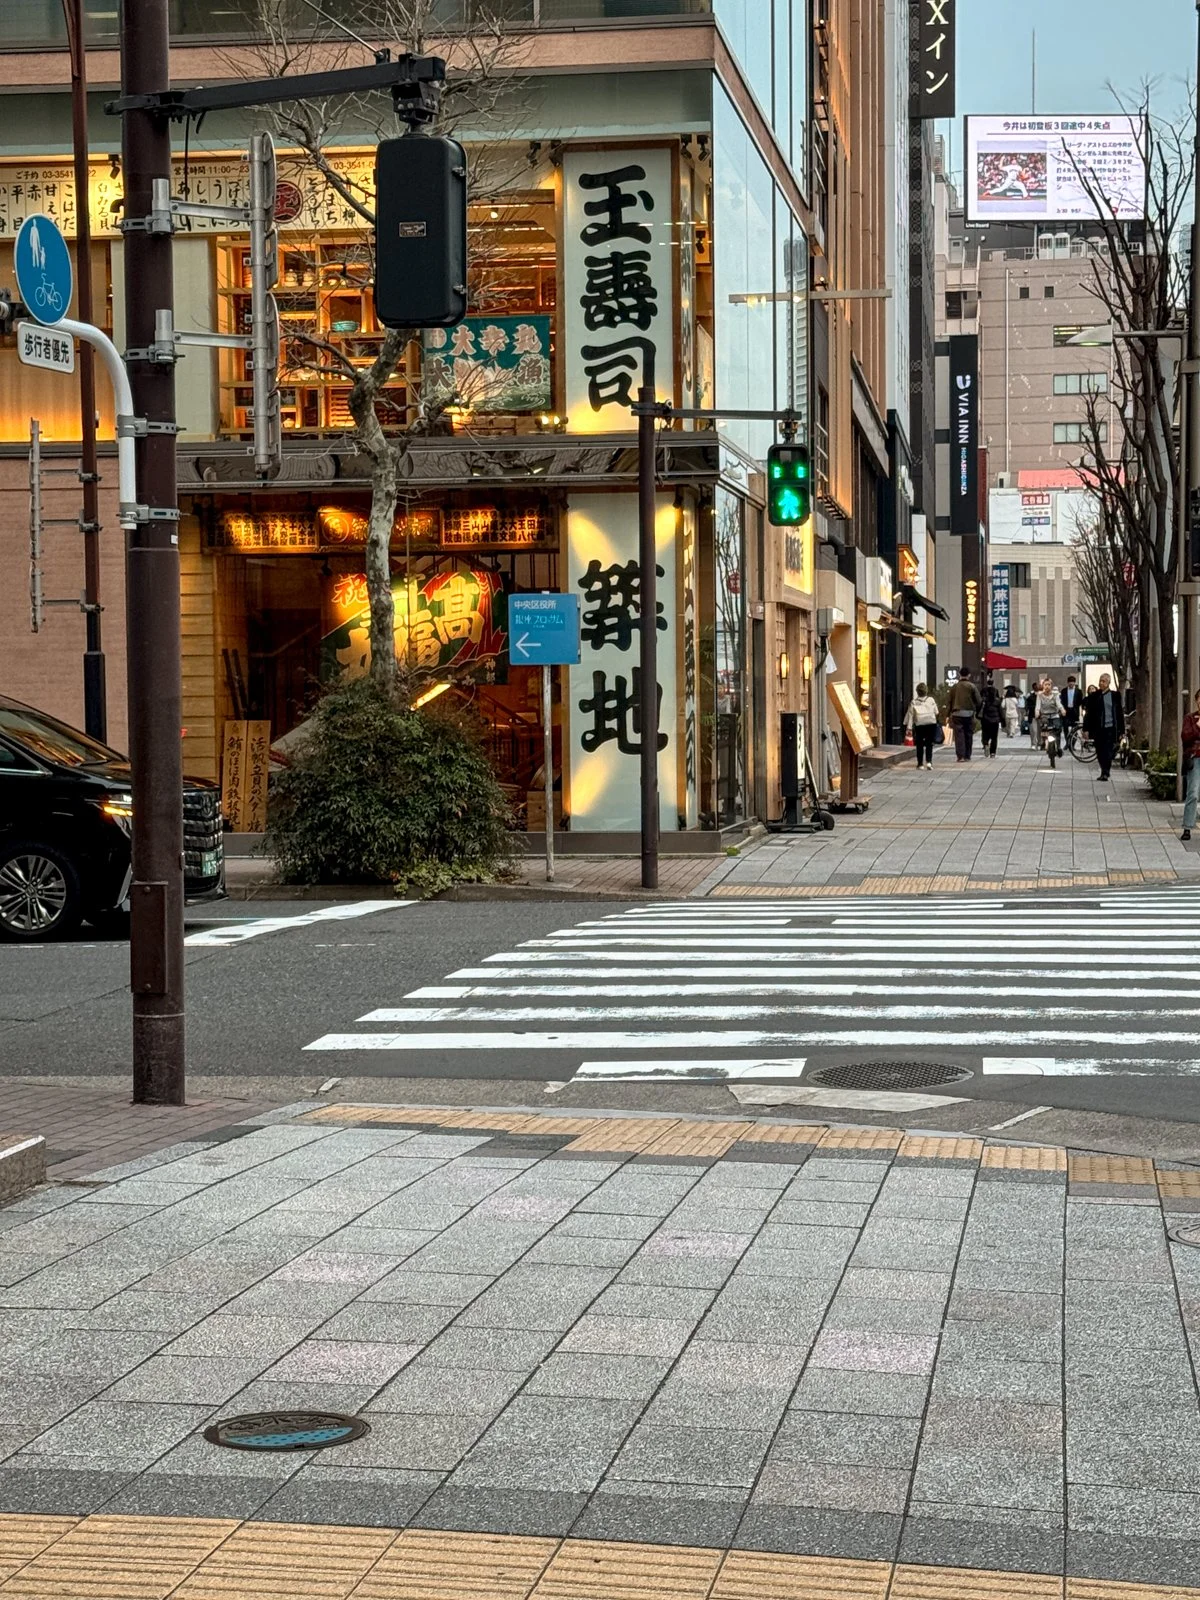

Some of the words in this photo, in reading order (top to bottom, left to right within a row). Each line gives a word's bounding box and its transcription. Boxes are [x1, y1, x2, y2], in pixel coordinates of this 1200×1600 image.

[25, 332, 69, 364] 歩行者優先
[958, 393, 969, 417] VIA
[958, 419, 969, 444] INN
[514, 599, 557, 610] 中央区役所
[993, 589, 1009, 643] 藤井商店
